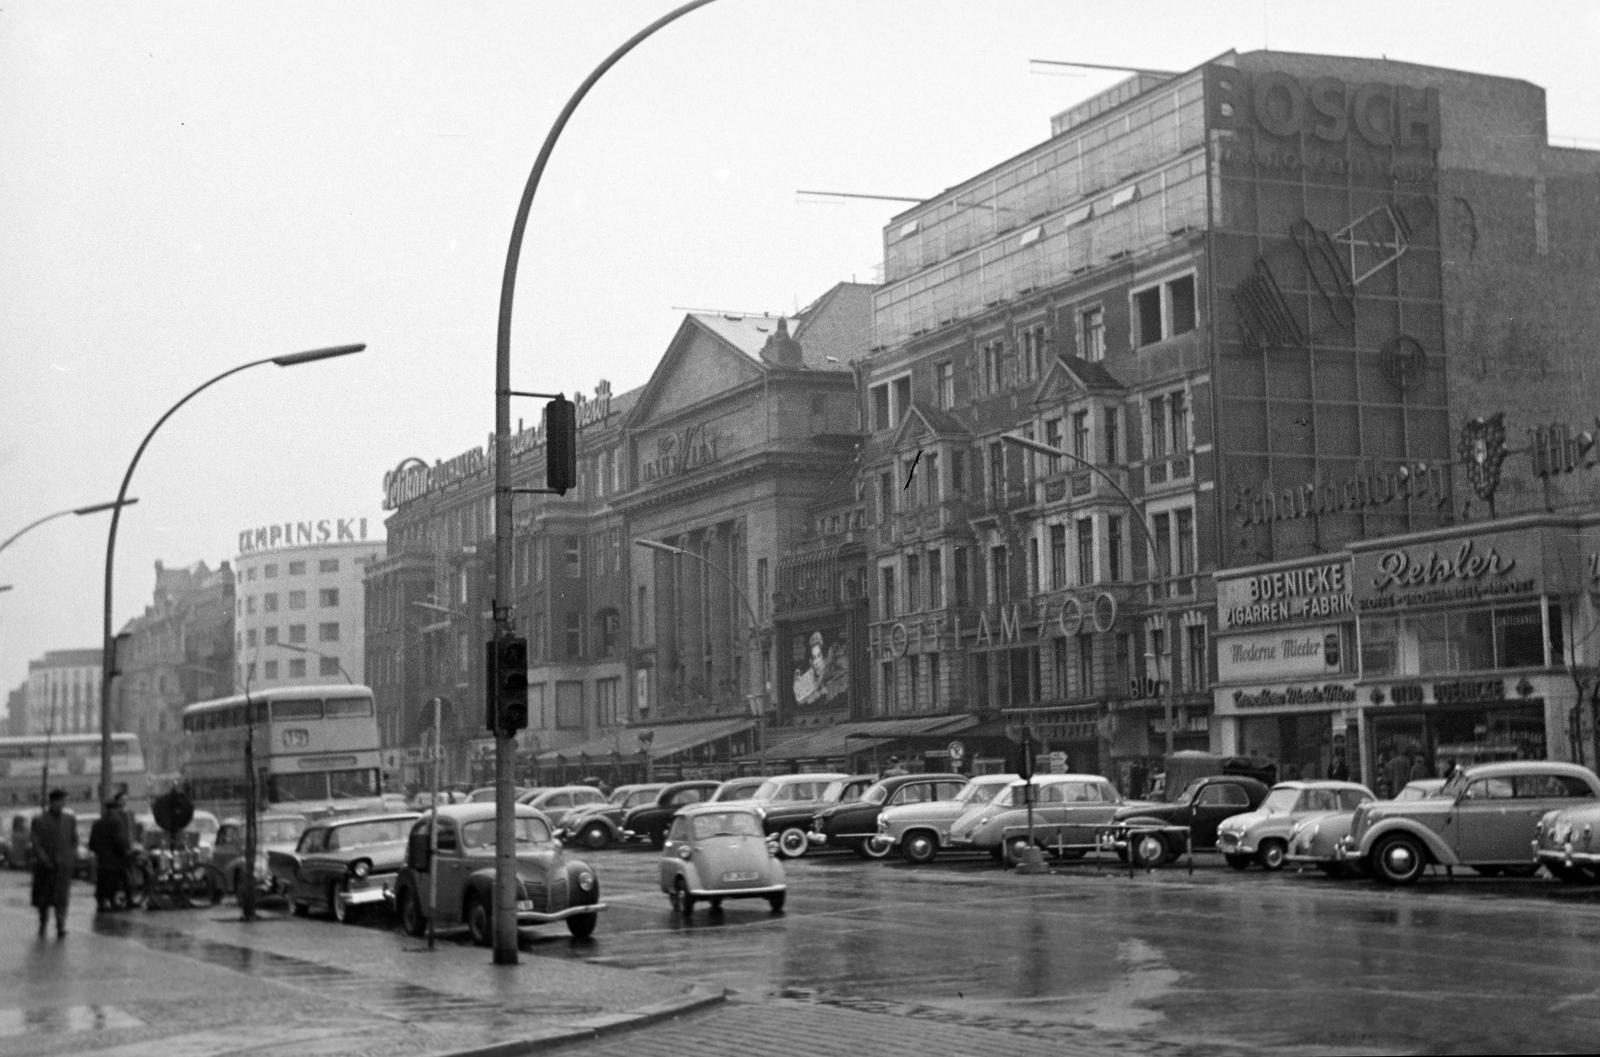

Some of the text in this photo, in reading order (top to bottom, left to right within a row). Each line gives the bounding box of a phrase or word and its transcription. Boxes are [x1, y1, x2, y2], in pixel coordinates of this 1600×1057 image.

[1203, 63, 1441, 151] BOSCH
[239, 517, 367, 552] KEMPINSKI
[1249, 563, 1341, 601] BOENICKE
[976, 603, 1021, 648] AM
[1038, 591, 1117, 640] ZOO
[1226, 600, 1289, 626] ZIGARREN
[1303, 593, 1355, 618] FABRIK
[1230, 637, 1321, 664] Moderne Mieder
